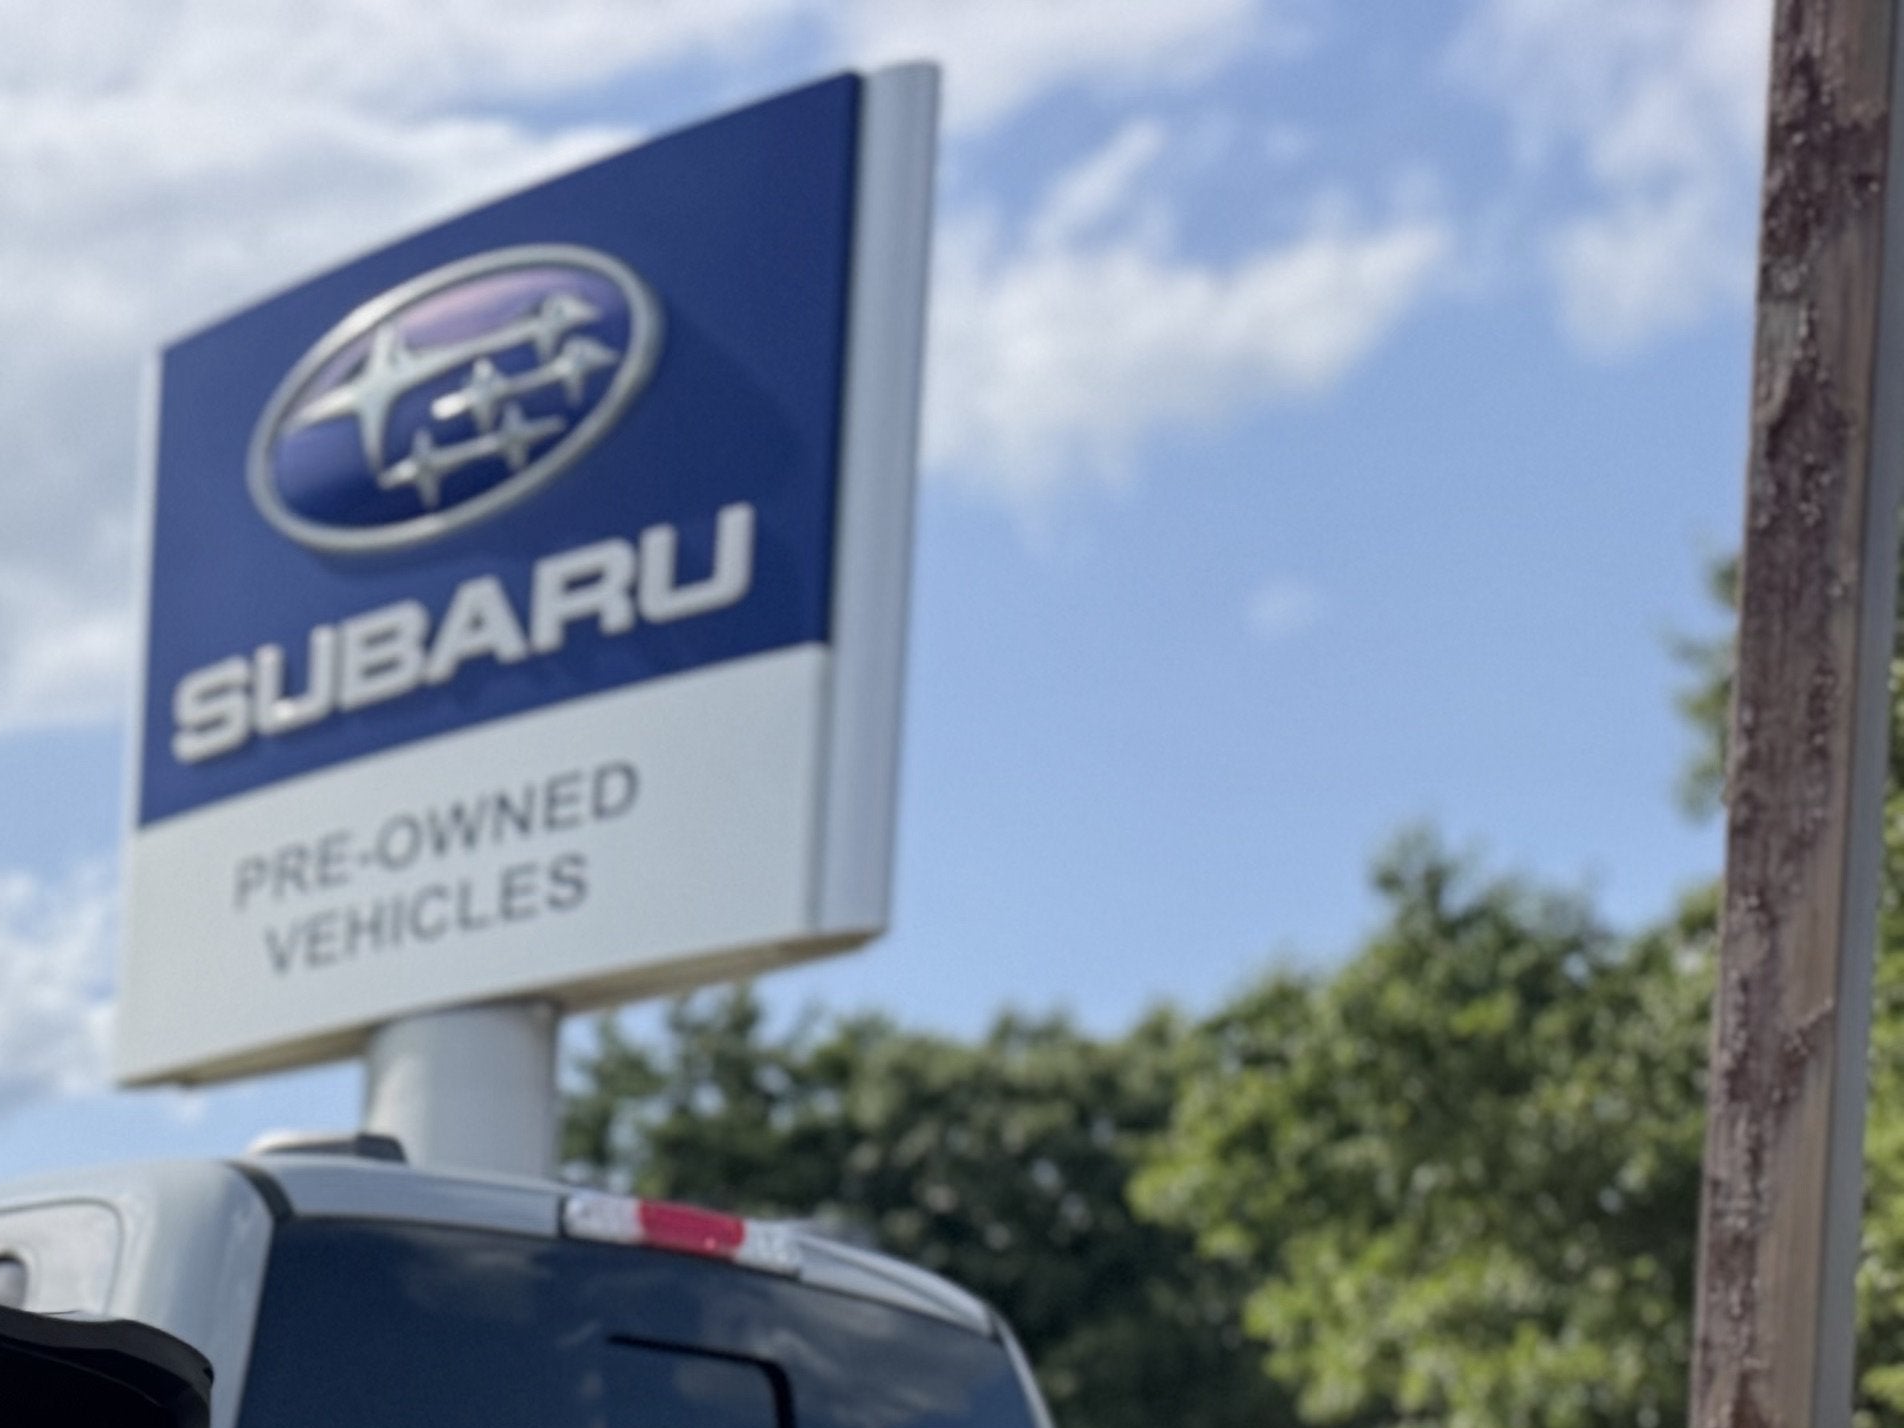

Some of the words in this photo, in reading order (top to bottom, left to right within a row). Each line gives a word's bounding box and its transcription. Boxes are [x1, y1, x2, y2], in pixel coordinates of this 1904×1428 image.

[172, 502, 754, 764] SUBARU
[232, 761, 642, 911] PRE-OWNED
[262, 852, 589, 977] VEHICLES
